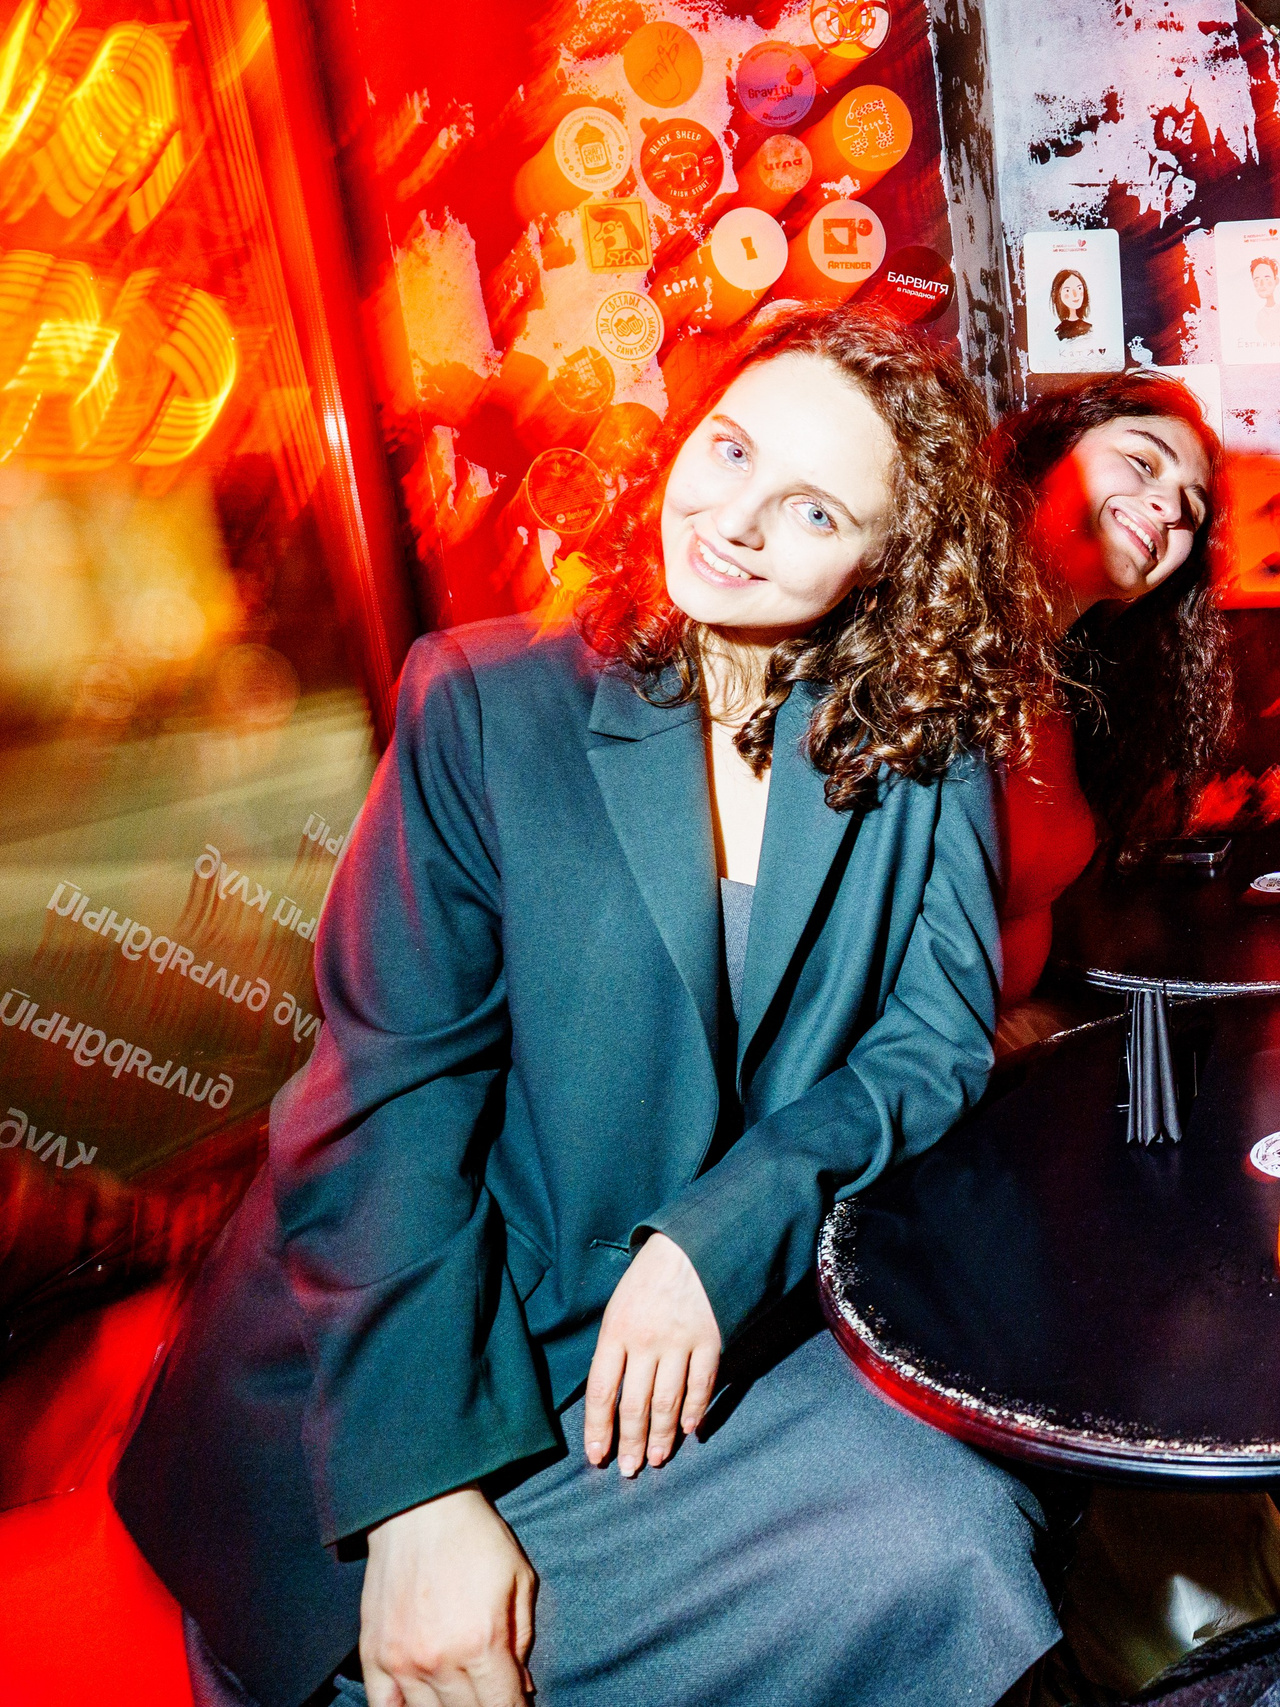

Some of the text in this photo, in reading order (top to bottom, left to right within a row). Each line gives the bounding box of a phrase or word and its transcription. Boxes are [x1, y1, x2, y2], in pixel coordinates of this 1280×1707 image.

[748, 84, 793, 99] Gravity
[583, 146, 603, 156] CRAFT
[649, 130, 702, 155] BLACK SHEEP
[585, 154, 604, 164] EVENT
[670, 179, 710, 198] IRISH STOUT
[827, 260, 872, 270] ARTENDER
[663, 276, 699, 297] БОРЯ
[887, 271, 949, 296] БАРВИТЯ
[600, 295, 641, 334] ДВА СВЕТЛЫХ
[615, 316, 656, 356] САНКТ-ПЕТЕРБУРГ
